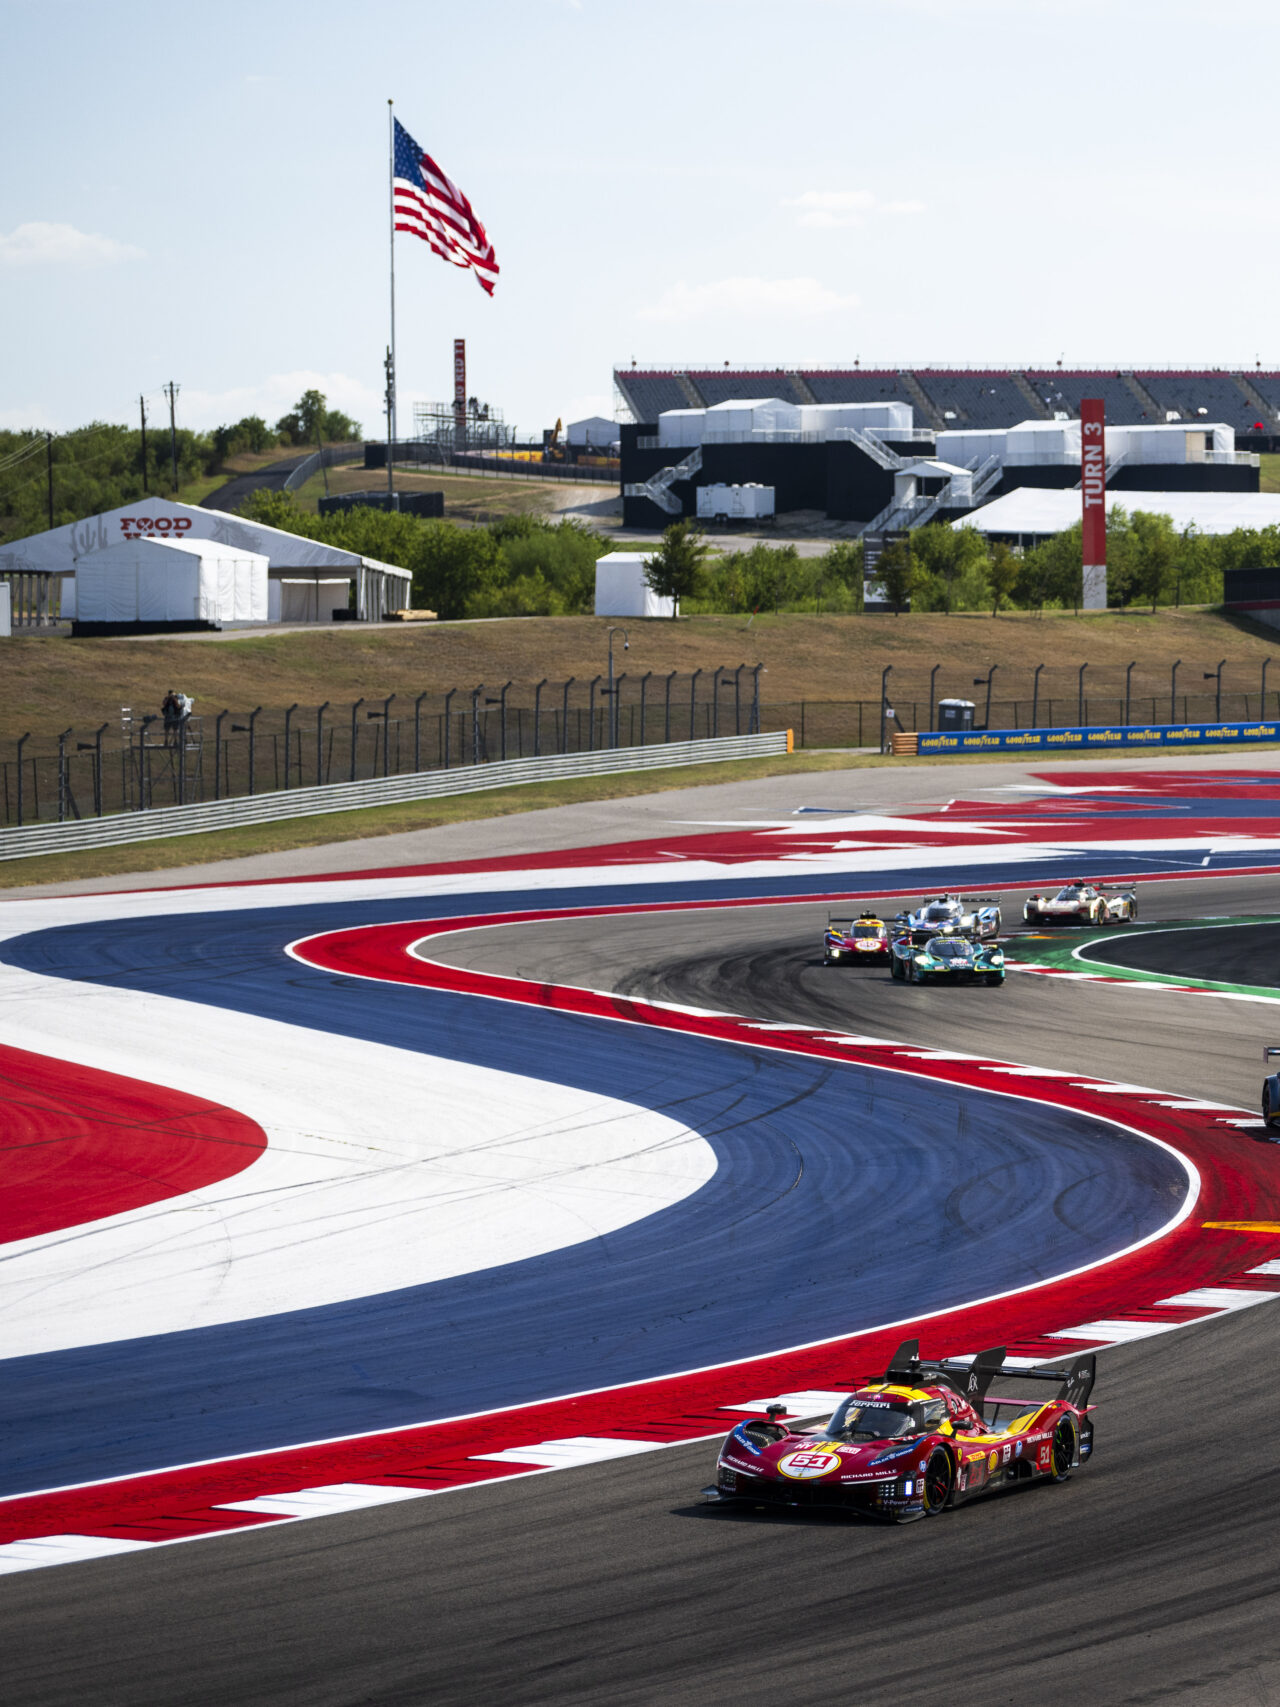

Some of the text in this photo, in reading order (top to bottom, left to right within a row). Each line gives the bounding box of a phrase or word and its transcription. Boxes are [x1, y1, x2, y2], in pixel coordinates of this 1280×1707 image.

[1083, 421, 1103, 509] TURN 3
[120, 517, 193, 531] FOOD
[849, 1400, 890, 1409] Ferrari
[791, 1453, 828, 1468] 51
[1040, 1445, 1050, 1465] 51
